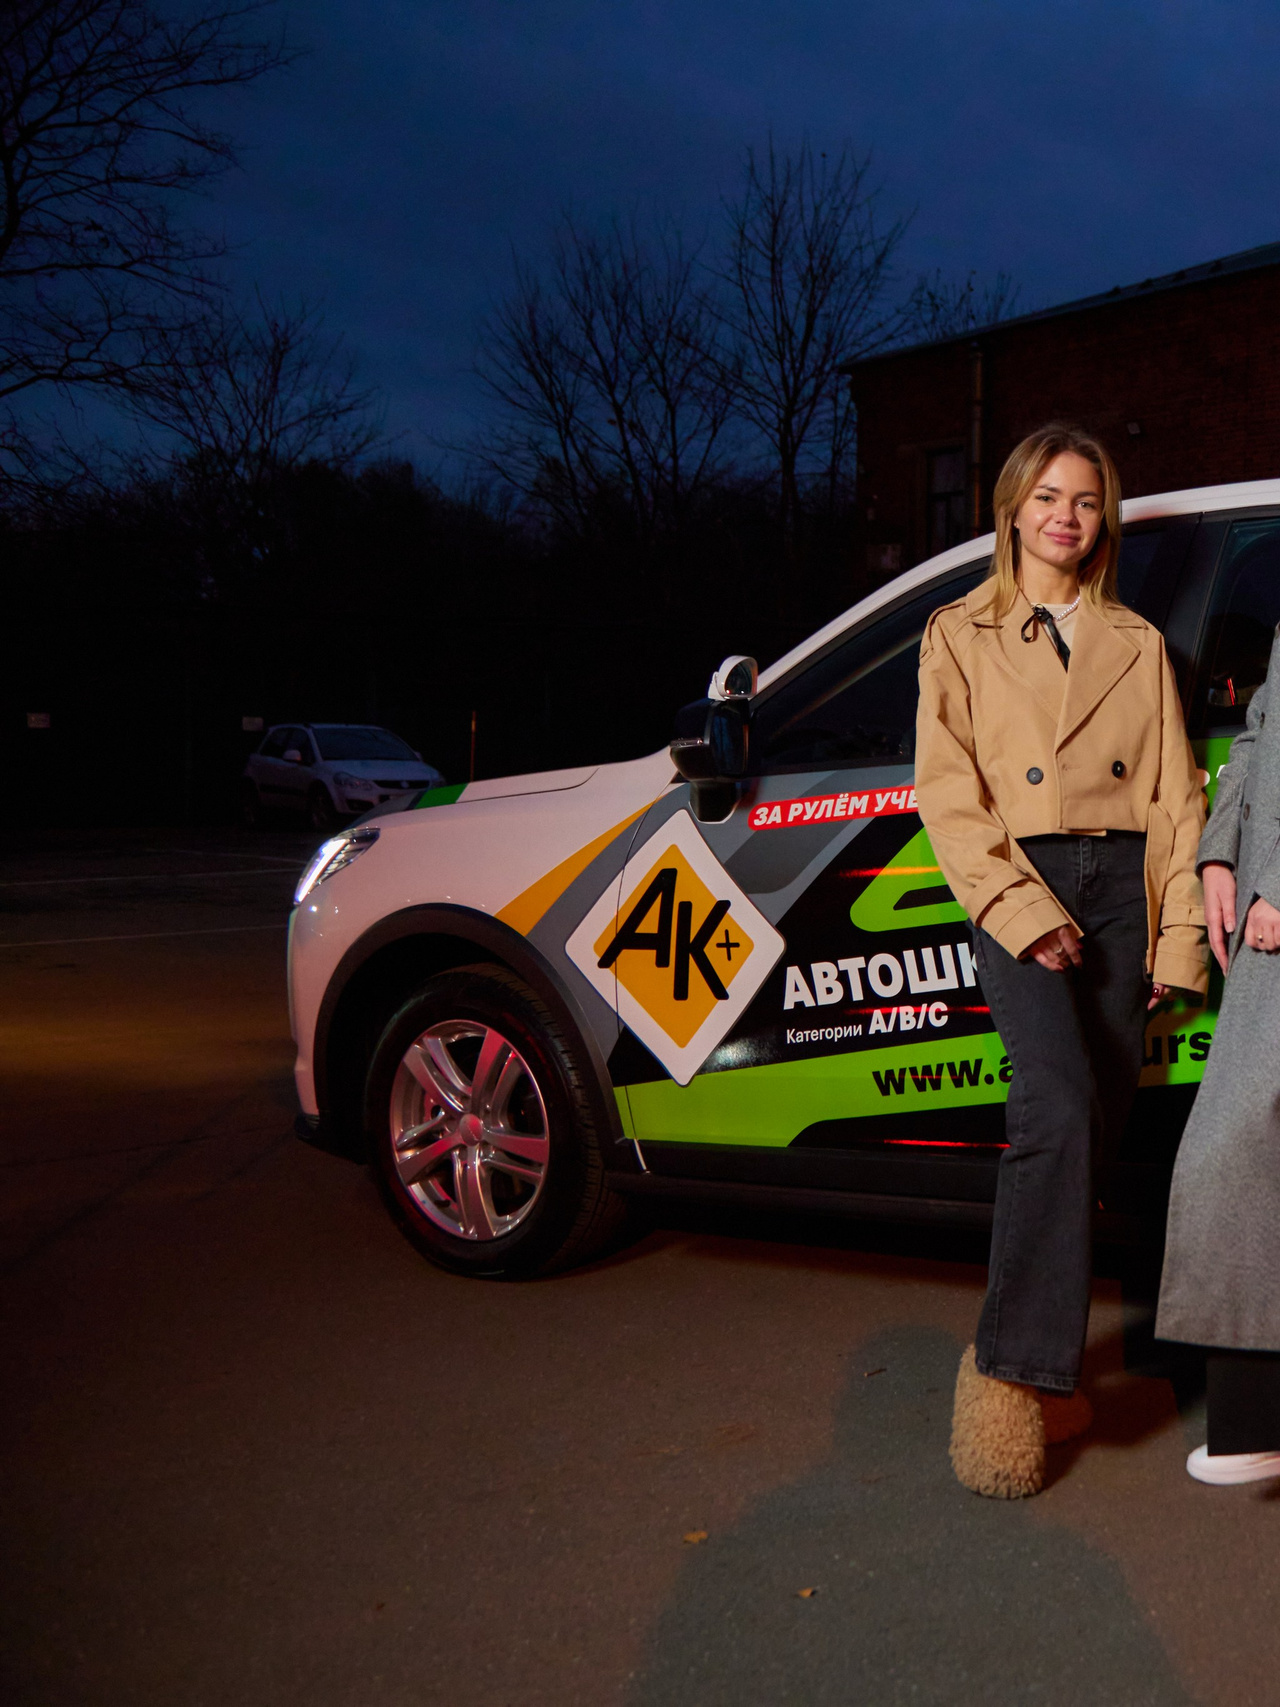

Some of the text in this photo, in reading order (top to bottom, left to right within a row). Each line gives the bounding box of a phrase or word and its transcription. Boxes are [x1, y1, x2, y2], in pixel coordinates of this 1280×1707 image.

[753, 805, 782, 826] ЗА
[787, 793, 870, 822] РУЛЁМ
[786, 1021, 863, 1044] Категории
